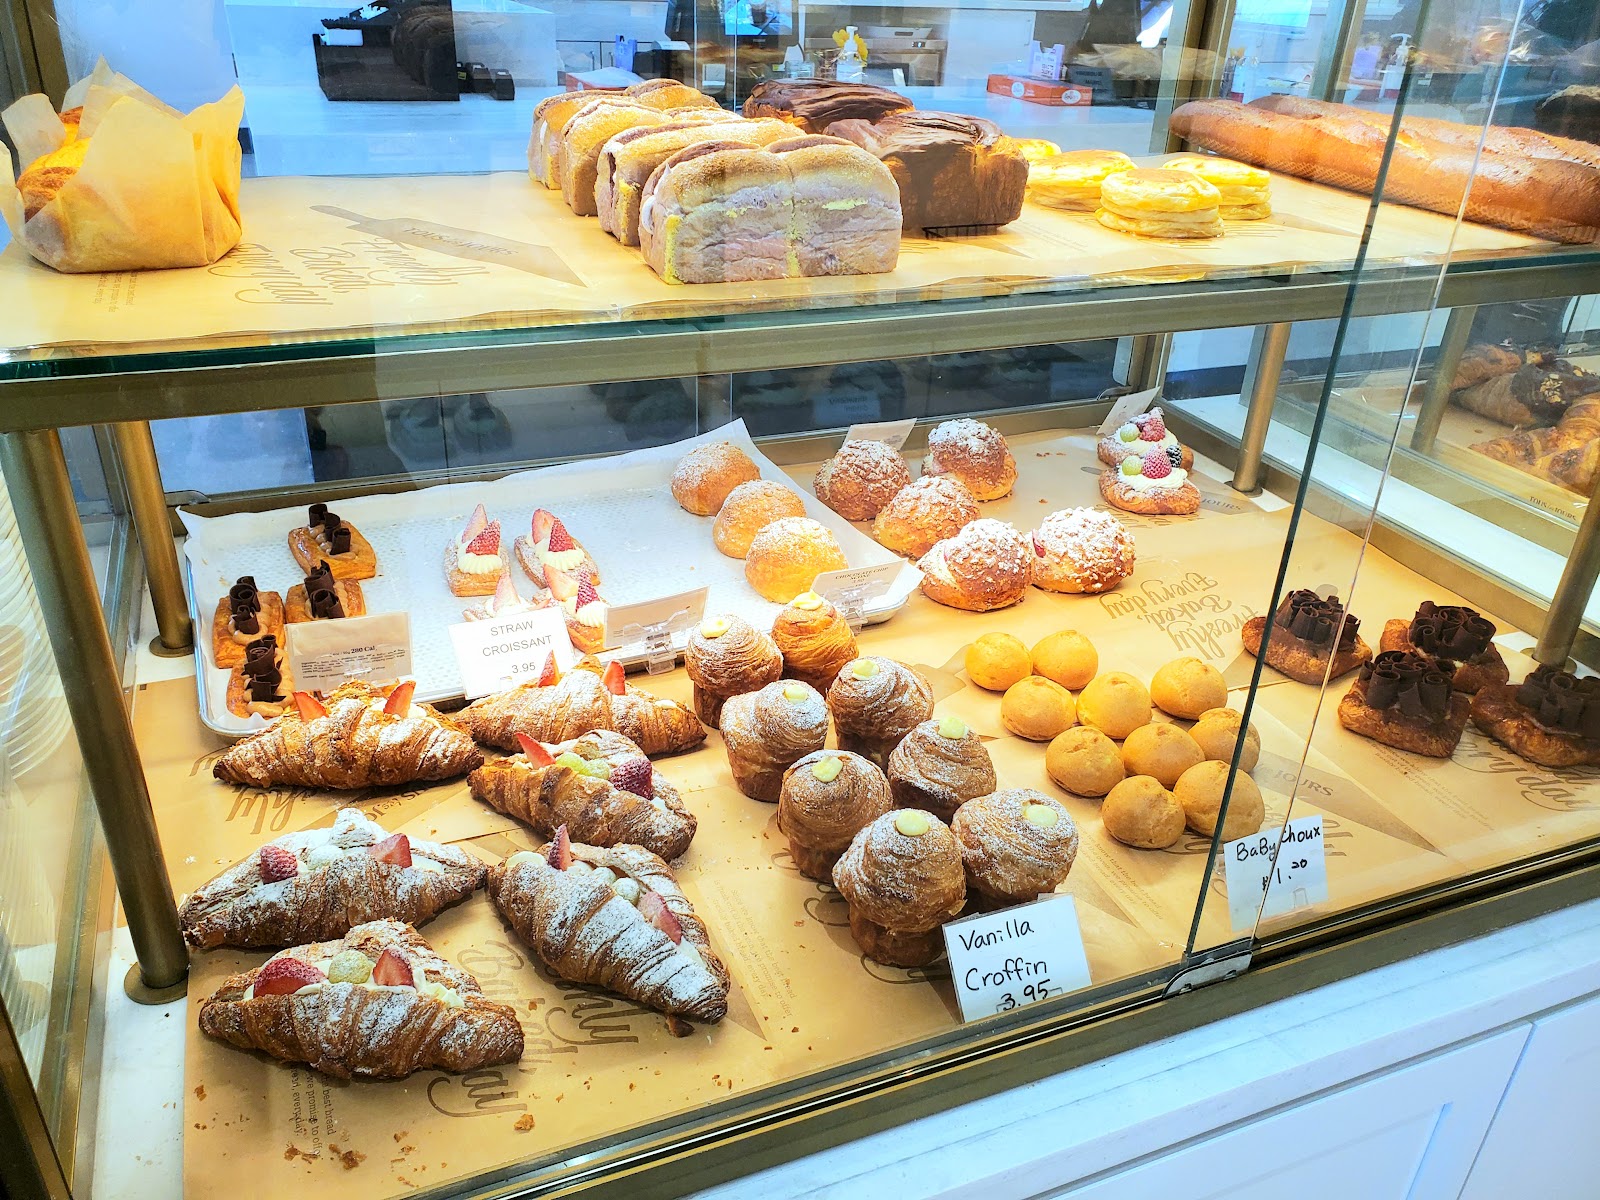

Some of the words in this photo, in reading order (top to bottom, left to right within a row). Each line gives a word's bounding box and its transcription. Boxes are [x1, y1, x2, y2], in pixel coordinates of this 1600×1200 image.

[490, 620, 534, 637] STRAW
[350, 646, 363, 654] 280
[481, 634, 553, 658] CROISSANT
[511, 661, 536, 674] 3.95
[1273, 769, 1335, 797] JOURS
[959, 918, 1035, 951] Vanilla
[965, 957, 1048, 991] Croffin
[1000, 978, 1051, 1011] 3.95
[305, 1089, 318, 1125] promise
[322, 1088, 333, 1109] best
[311, 1125, 320, 1136] to
[325, 1108, 337, 1136] bread
